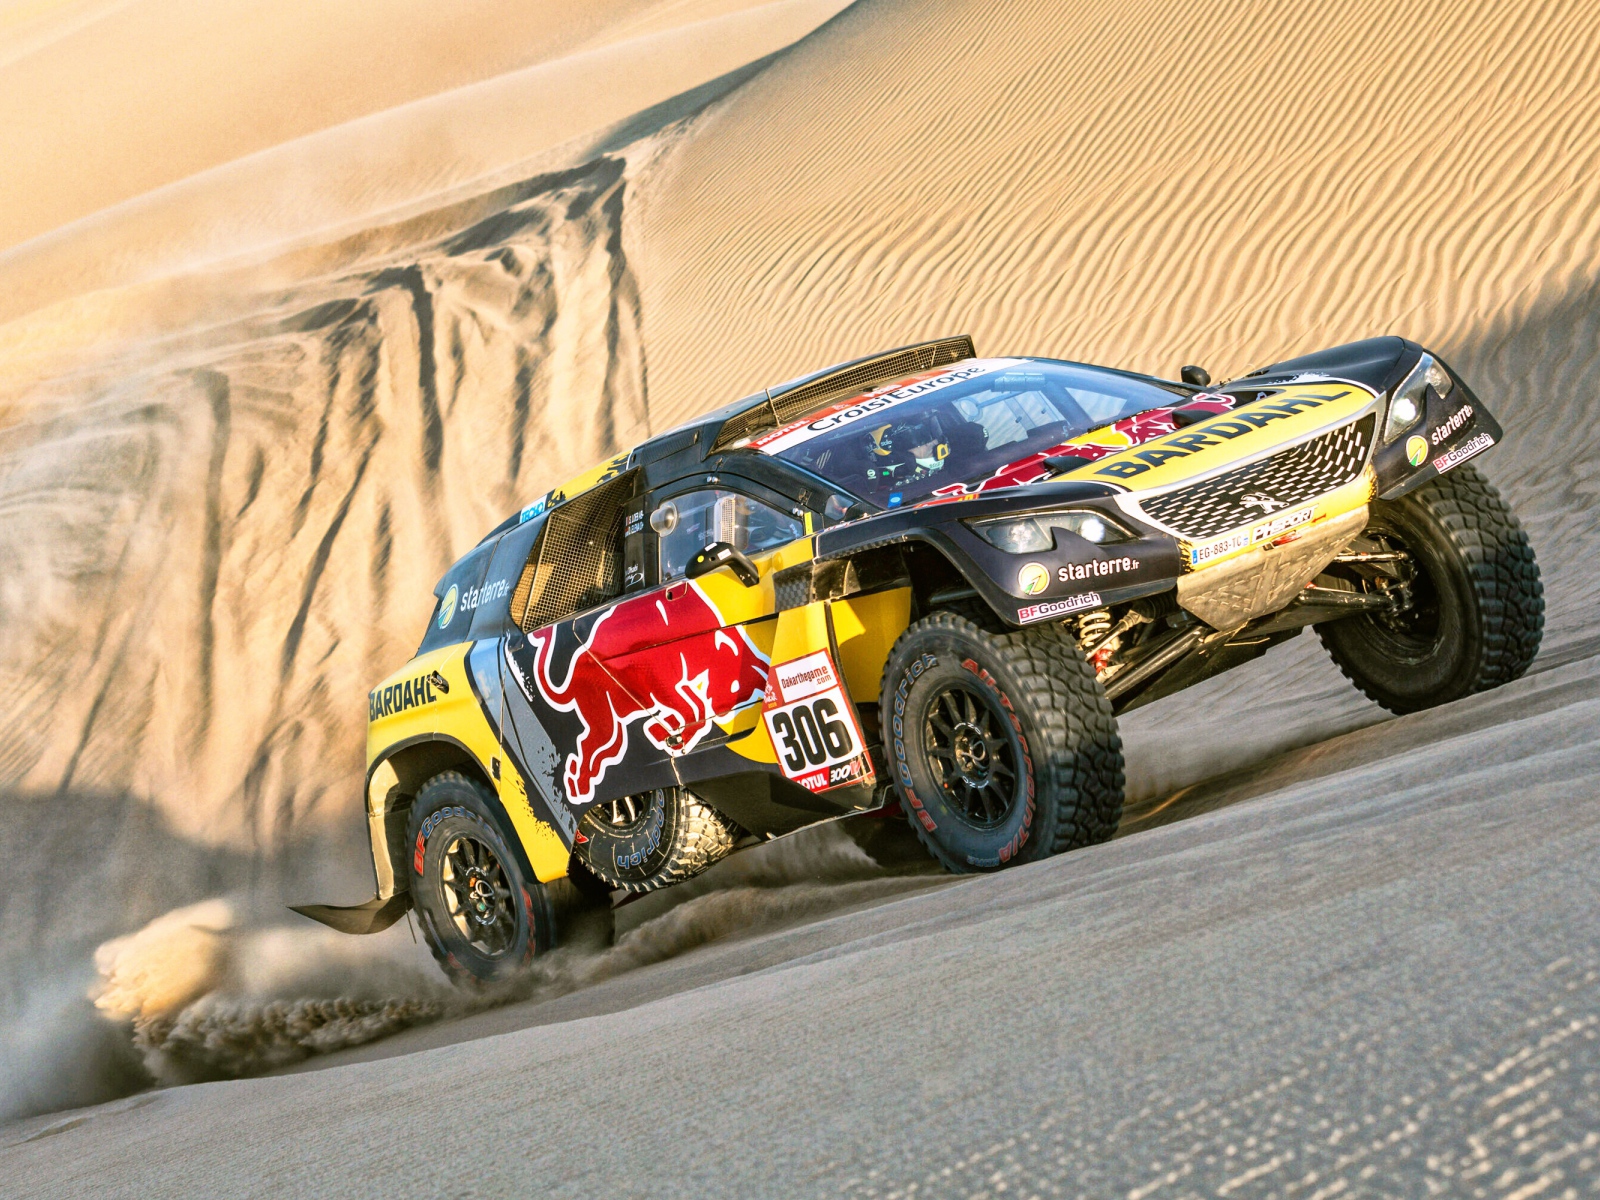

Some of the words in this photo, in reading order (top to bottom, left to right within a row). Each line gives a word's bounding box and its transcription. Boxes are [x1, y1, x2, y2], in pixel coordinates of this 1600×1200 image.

[807, 366, 986, 432] CroisiEurope
[756, 418, 811, 446] MOTUL
[1093, 391, 1352, 479] BARDAHL
[1434, 432, 1491, 469] BFGoodrich
[1199, 538, 1242, 561] EG-883-TC
[1058, 557, 1140, 582] starterre.fr
[1019, 592, 1100, 620] BFGoodrich
[781, 665, 829, 689] Dakarthegame
[816, 674, 832, 685] .com
[369, 674, 437, 722] BARDAHL
[772, 698, 853, 772] 306
[893, 653, 938, 832] BFGoodrich
